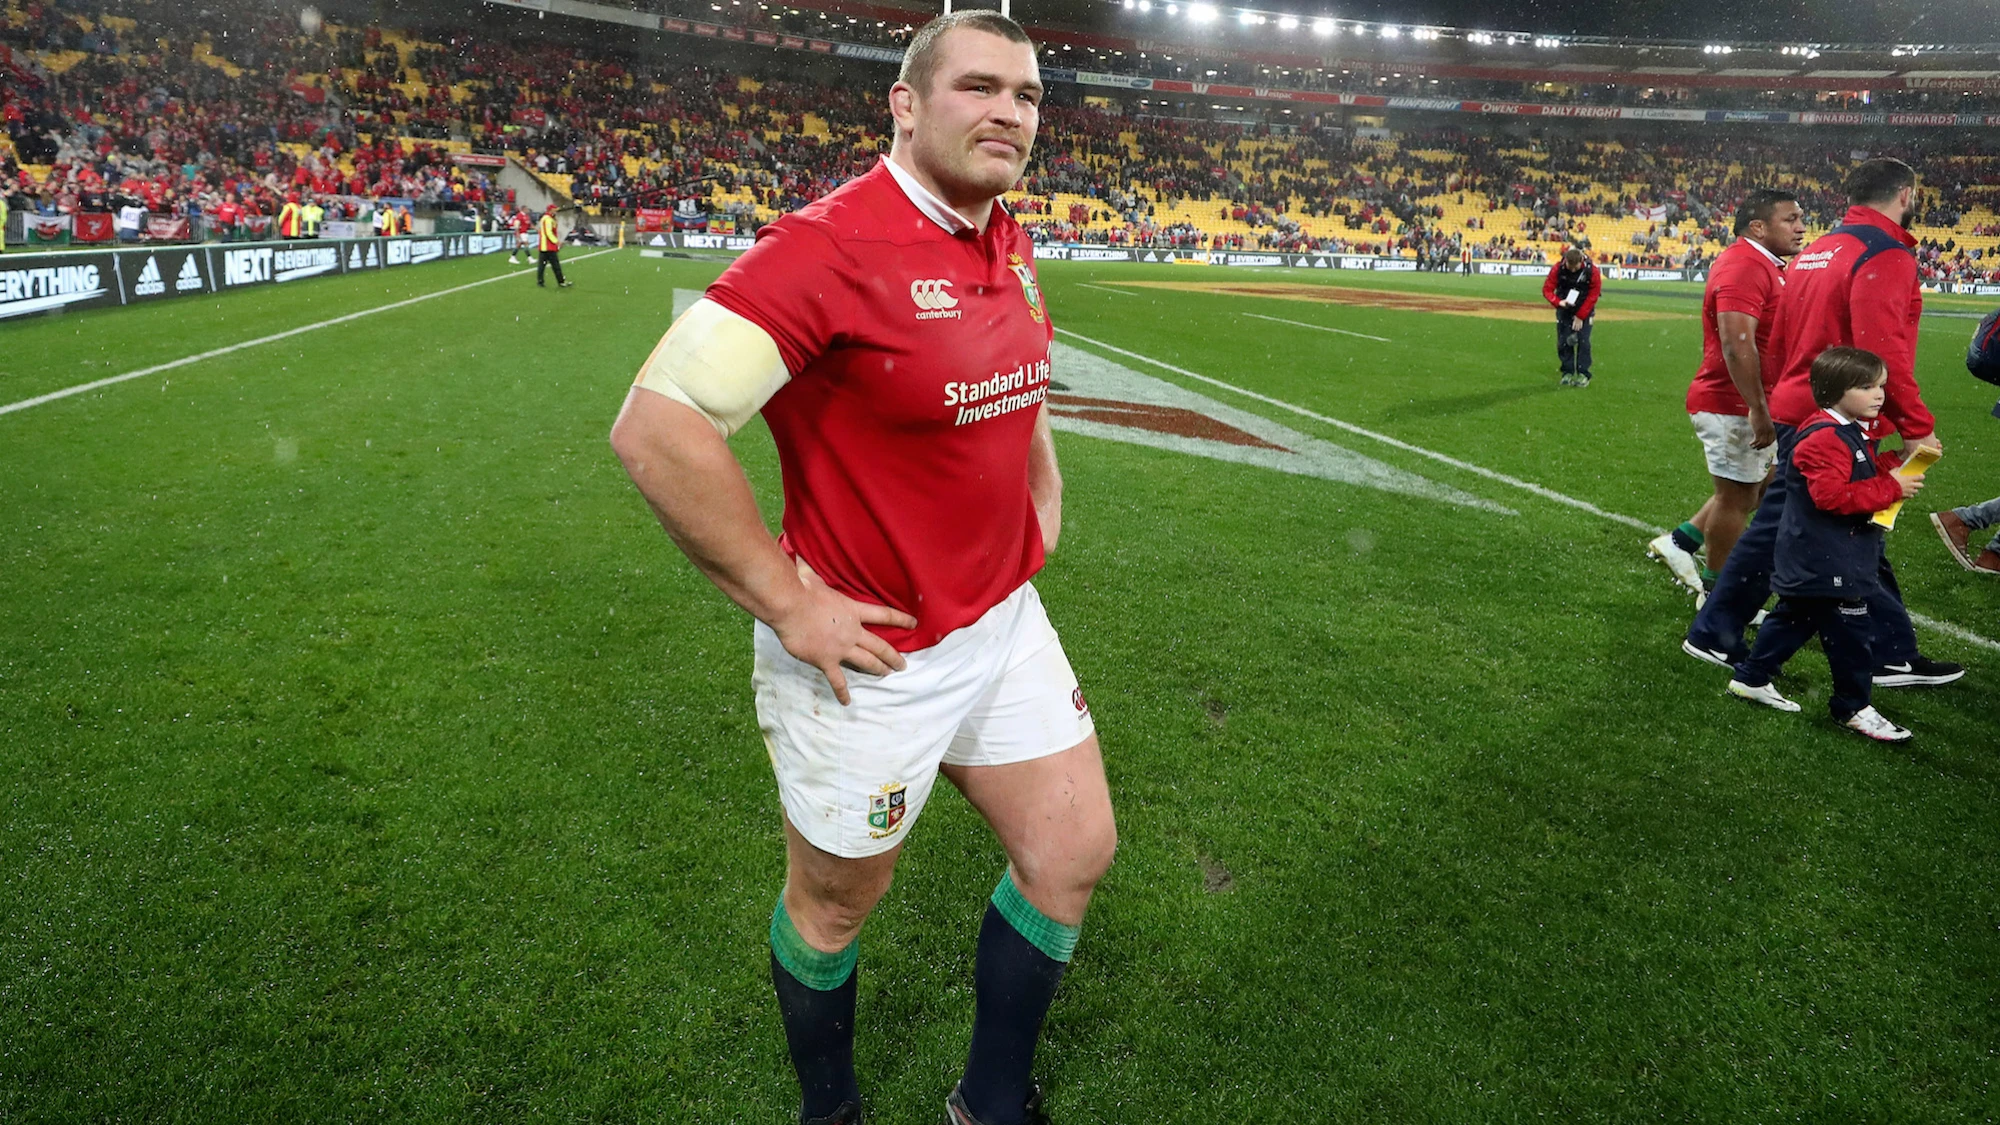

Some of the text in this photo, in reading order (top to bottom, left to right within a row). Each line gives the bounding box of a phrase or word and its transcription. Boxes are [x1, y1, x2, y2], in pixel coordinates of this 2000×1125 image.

[1255, 88, 1293, 99] Westpac
[1387, 98, 1460, 110] MAINFREIGHT
[1541, 105, 1620, 118] DAILY FREIGHT
[1802, 113, 1862, 124] KENNARDS
[1892, 114, 1954, 124] KENNARDS
[683, 234, 724, 249] NEXT
[1033, 247, 1069, 260] NEXT
[1080, 250, 1129, 259] EVERYTHING
[1228, 255, 1235, 263] IS
[1236, 255, 1282, 264] EVERYTHING
[224, 247, 337, 286] NEXT IS EVERYTHING
[1341, 258, 1372, 269] NEXT
[1480, 263, 1510, 274] NEXT
[915, 308, 962, 321] canterbury
[944, 359, 1050, 407] Standard Life
[954, 386, 1048, 427] Investments
